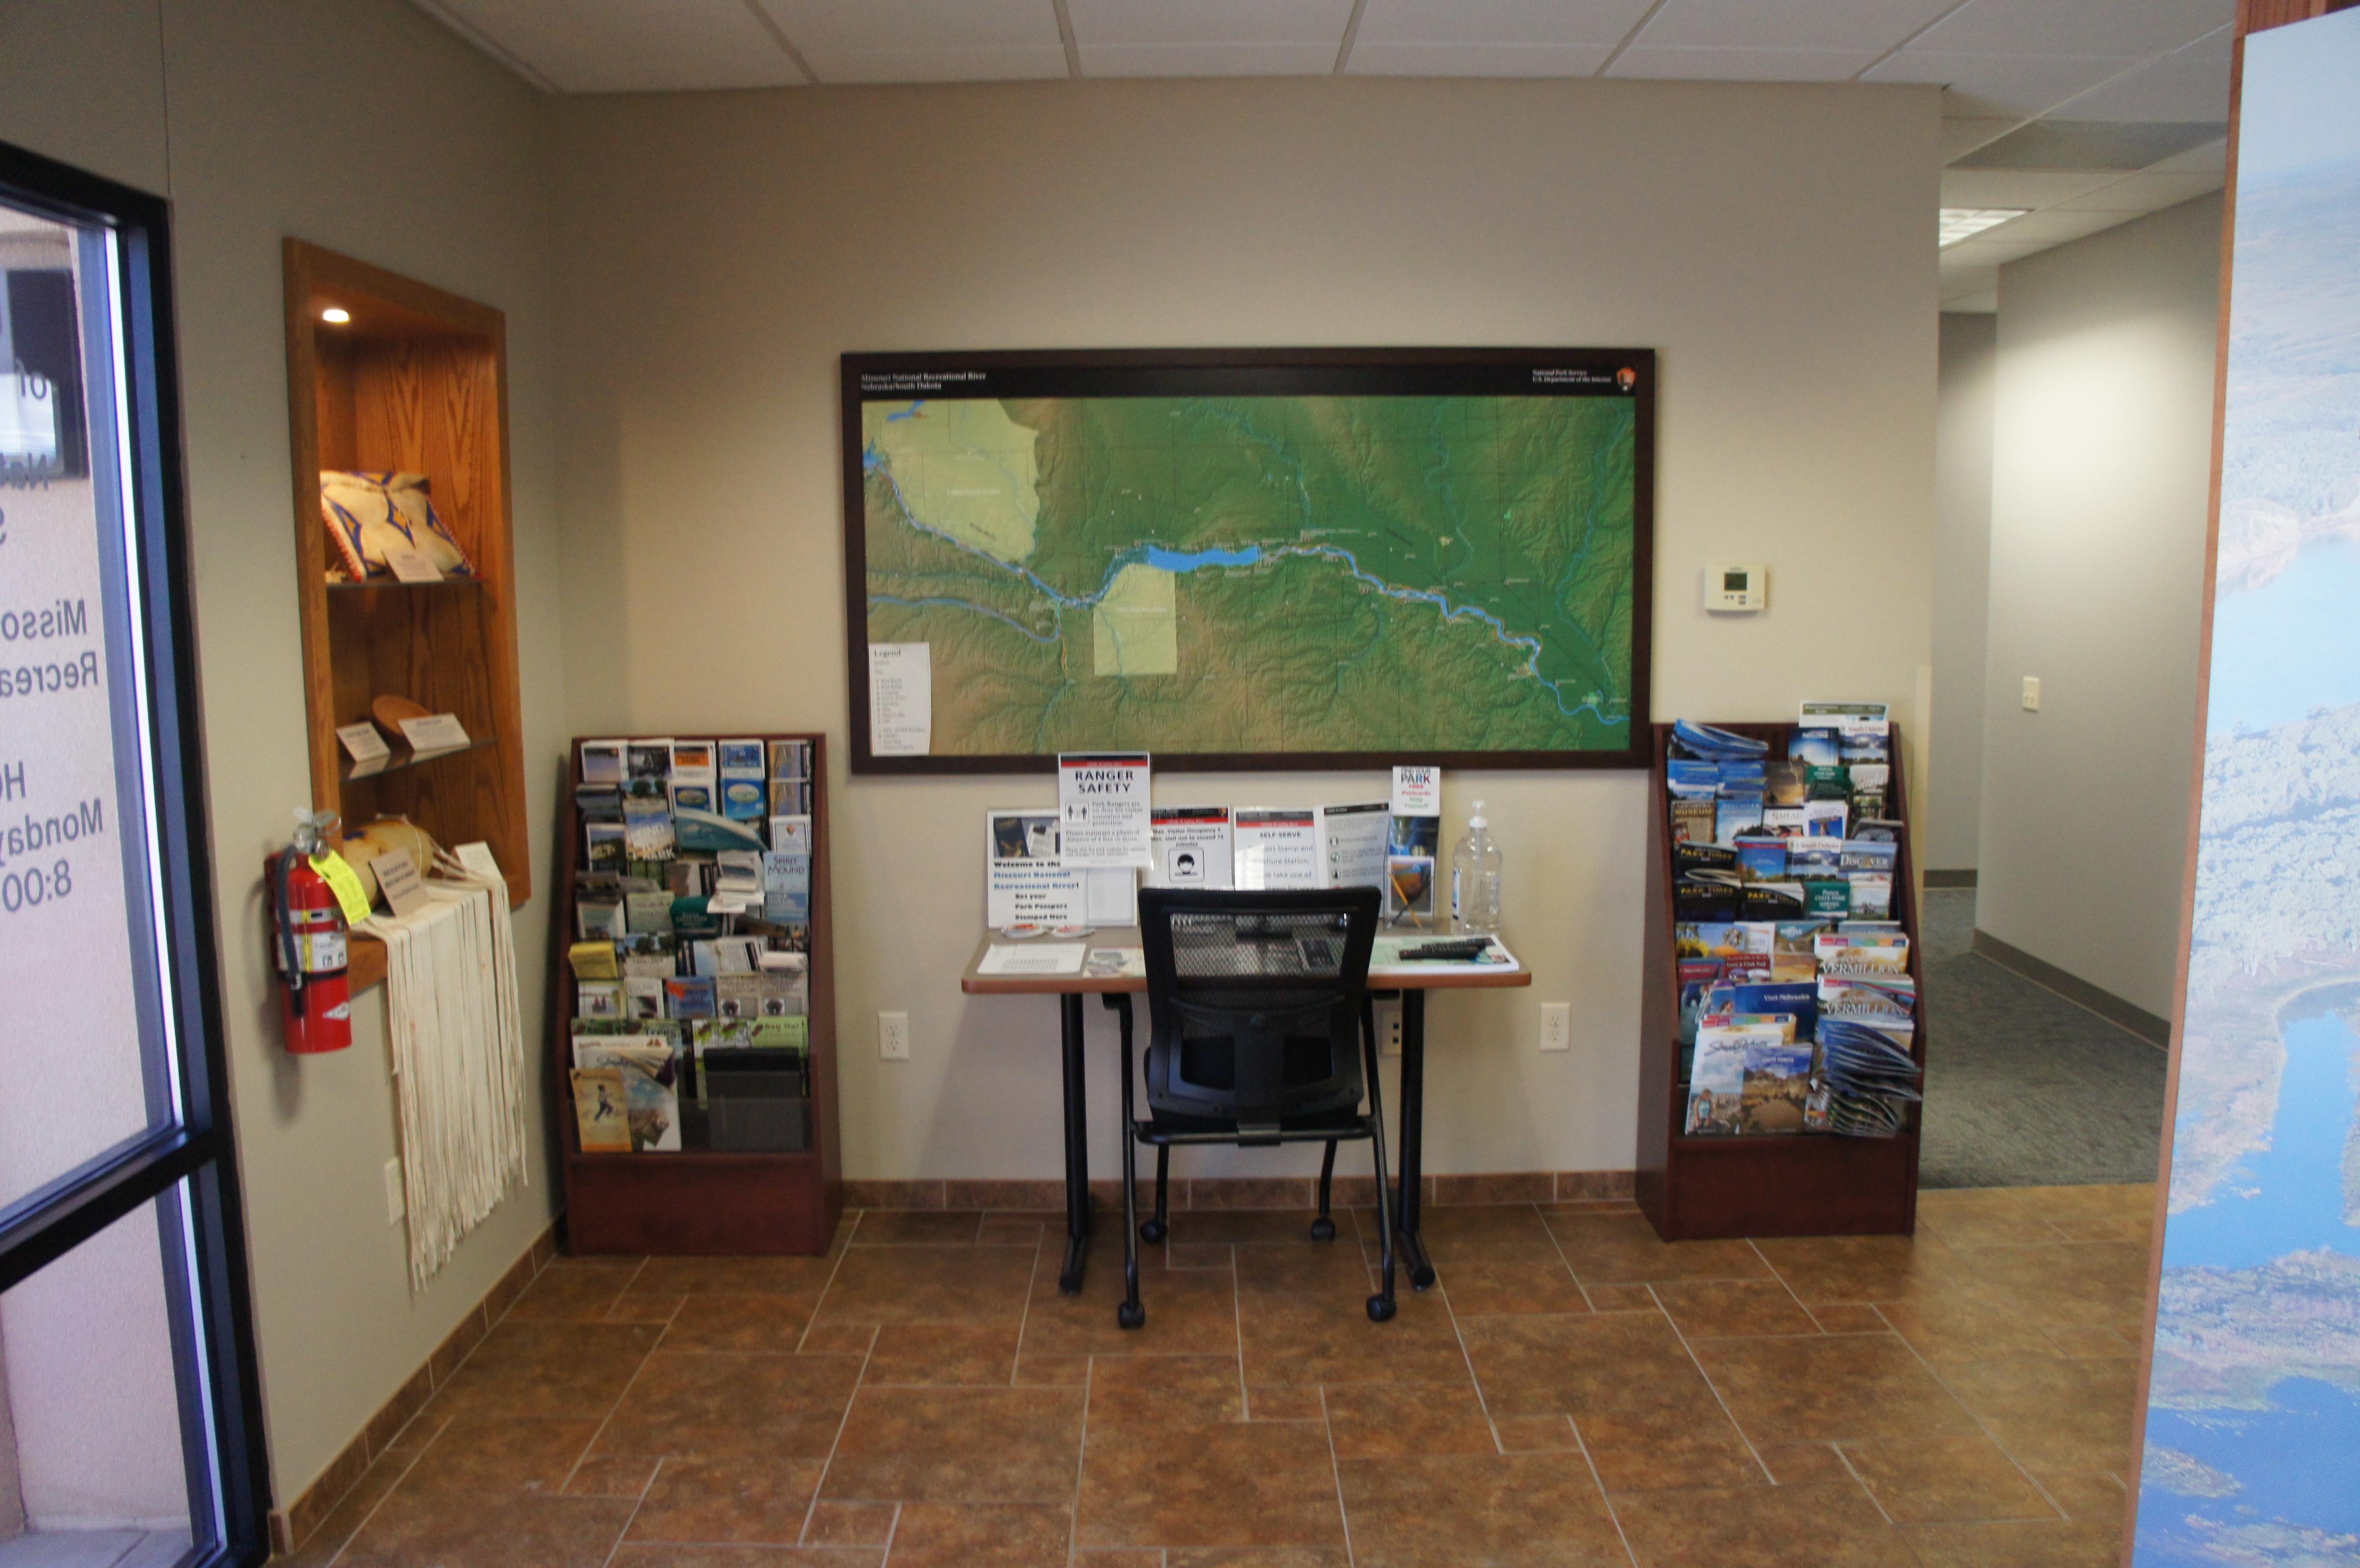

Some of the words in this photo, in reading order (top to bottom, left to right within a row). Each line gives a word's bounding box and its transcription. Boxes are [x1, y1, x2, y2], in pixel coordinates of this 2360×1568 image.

[893, 372, 922, 381] National
[924, 372, 966, 381] Recreational
[968, 371, 987, 380] River
[874, 649, 901, 658] Legend
[1075, 770, 1133, 782] RANGER
[1401, 773, 1430, 784] PARK
[1079, 782, 1131, 794] SAFETY
[774, 855, 797, 865] SPIRIT
[768, 865, 805, 875] MOUND
[1822, 963, 1899, 975] VERMILLION
[1779, 993, 1810, 1001] Nebraska
